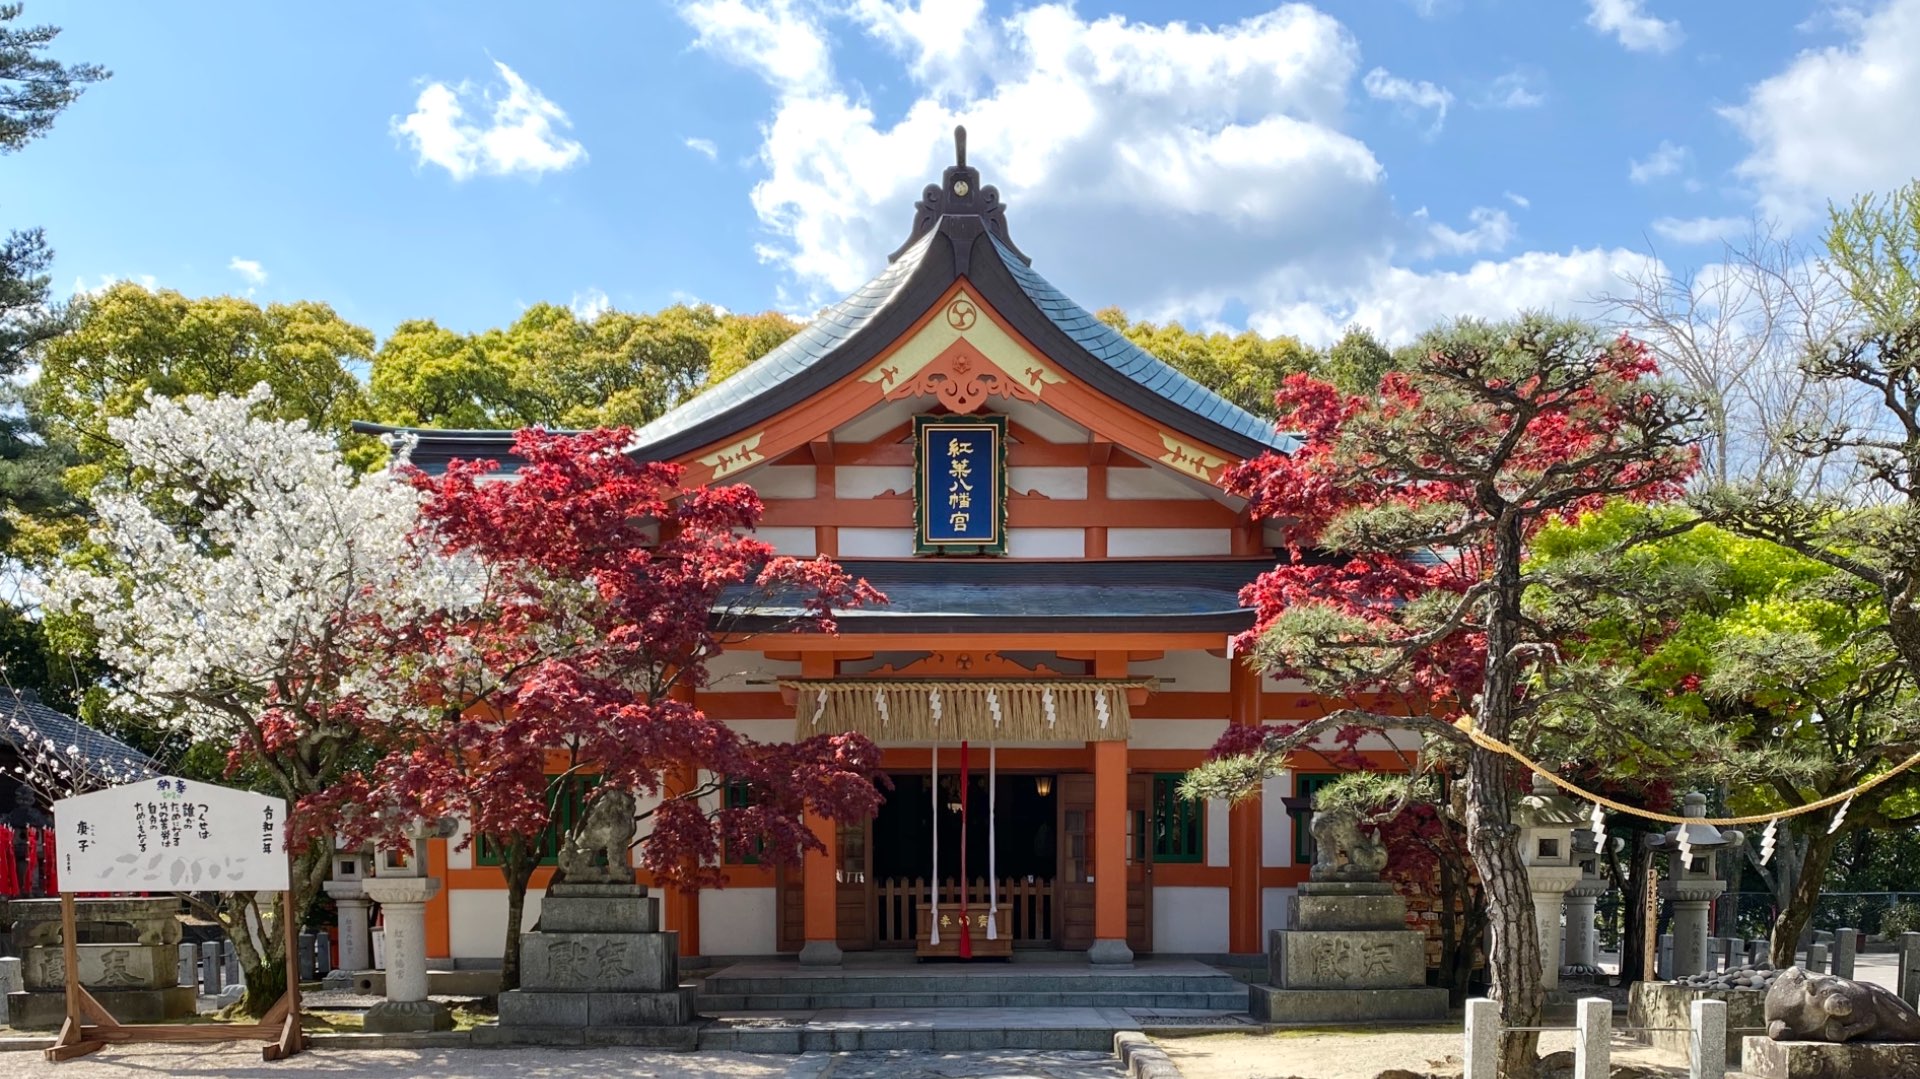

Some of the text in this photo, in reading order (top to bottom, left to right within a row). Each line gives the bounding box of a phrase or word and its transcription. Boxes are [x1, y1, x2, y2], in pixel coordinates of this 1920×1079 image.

[946, 437, 974, 532] 紅葉八幡宮
[170, 802, 182, 847] ためになる
[182, 802, 196, 829] 誰かの
[198, 803, 212, 840] つくせば
[263, 804, 274, 854] 令和二年
